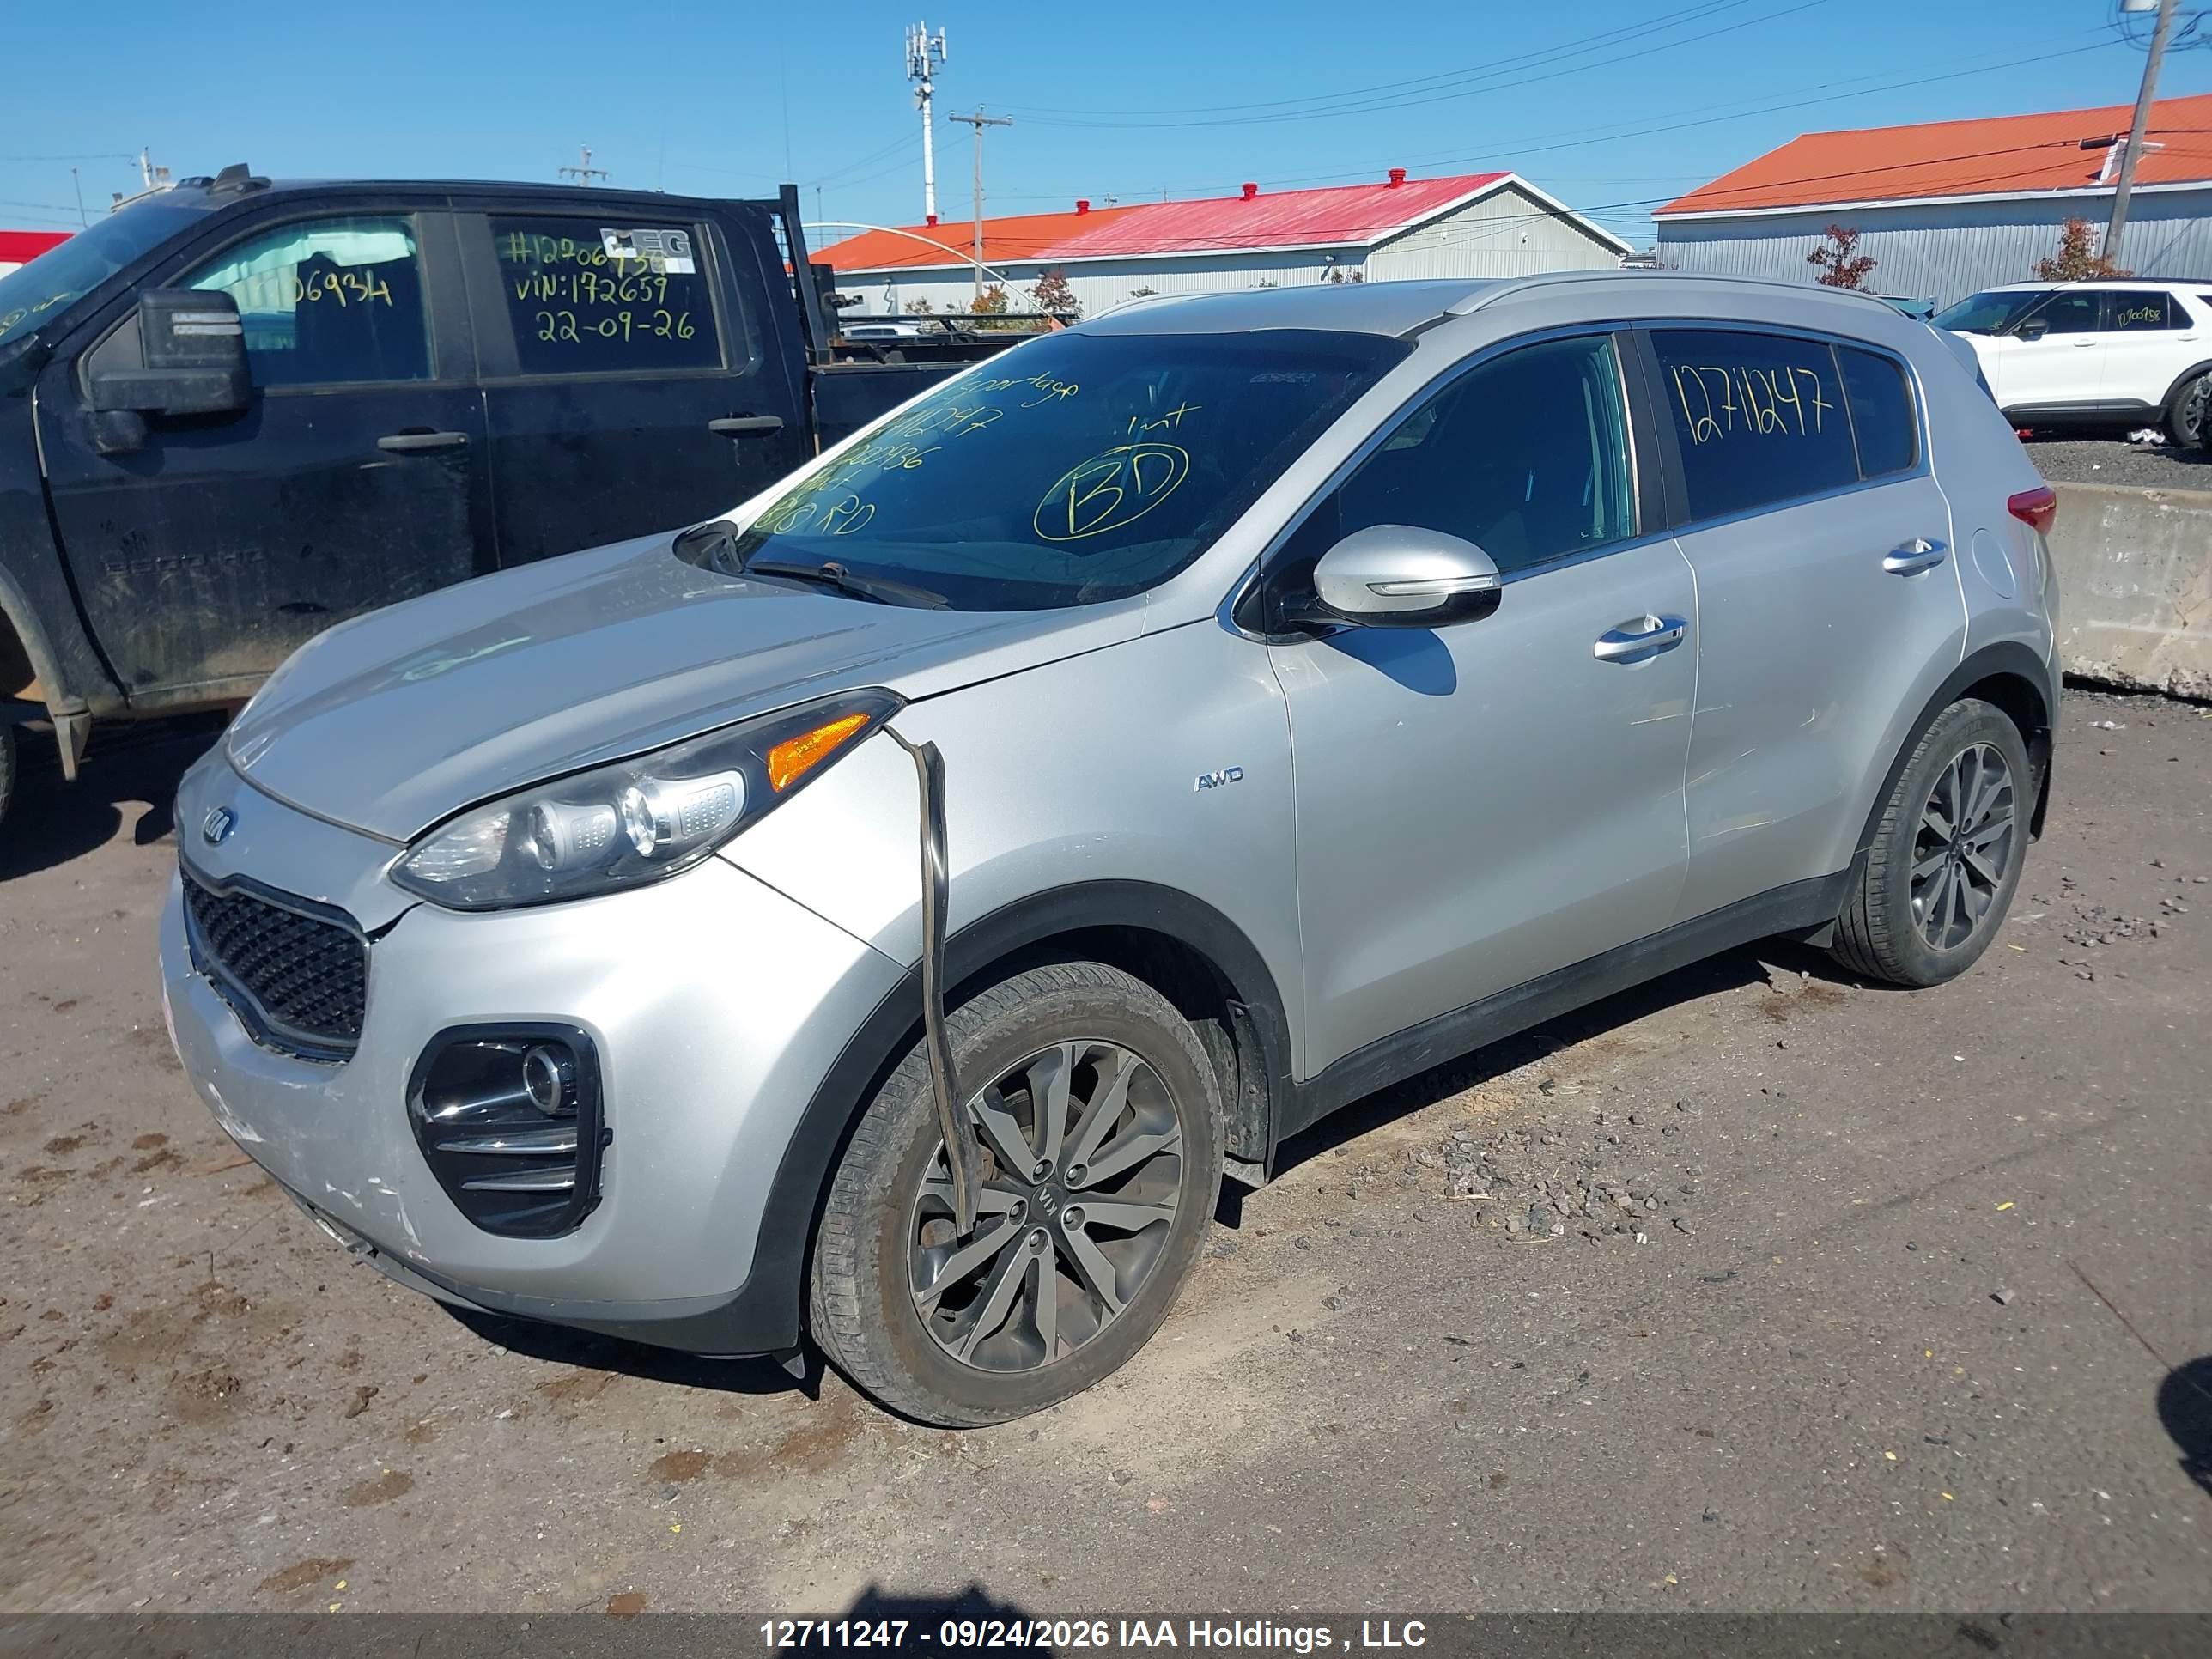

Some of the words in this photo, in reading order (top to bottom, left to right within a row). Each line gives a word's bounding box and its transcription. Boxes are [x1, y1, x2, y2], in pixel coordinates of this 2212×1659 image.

[535, 309, 695, 343] 22-09-26
[1670, 365, 1834, 446] 12711247
[1068, 452, 1176, 535] BD
[1194, 765, 1244, 793] AWD
[1038, 1187, 1059, 1218] KIA
